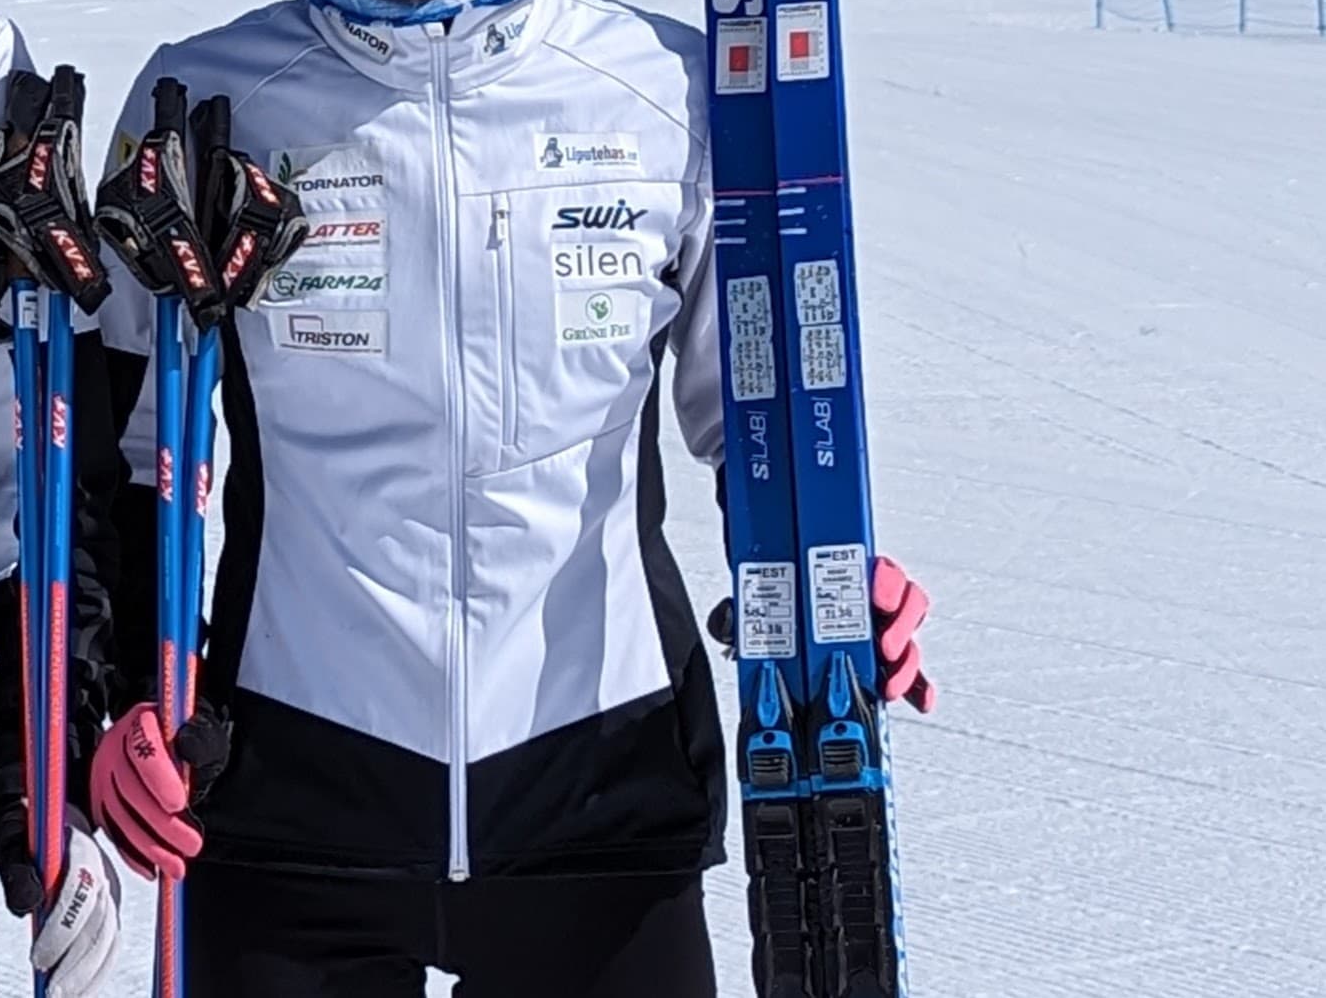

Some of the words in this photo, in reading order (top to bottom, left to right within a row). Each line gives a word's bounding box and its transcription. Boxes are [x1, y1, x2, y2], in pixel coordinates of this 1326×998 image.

[293, 174, 383, 192] TORNATOR
[555, 244, 643, 277] silen
[298, 274, 384, 292] FARM24
[294, 331, 370, 346] TRISTON
[833, 548, 858, 561] EST
[762, 567, 787, 579] EST
